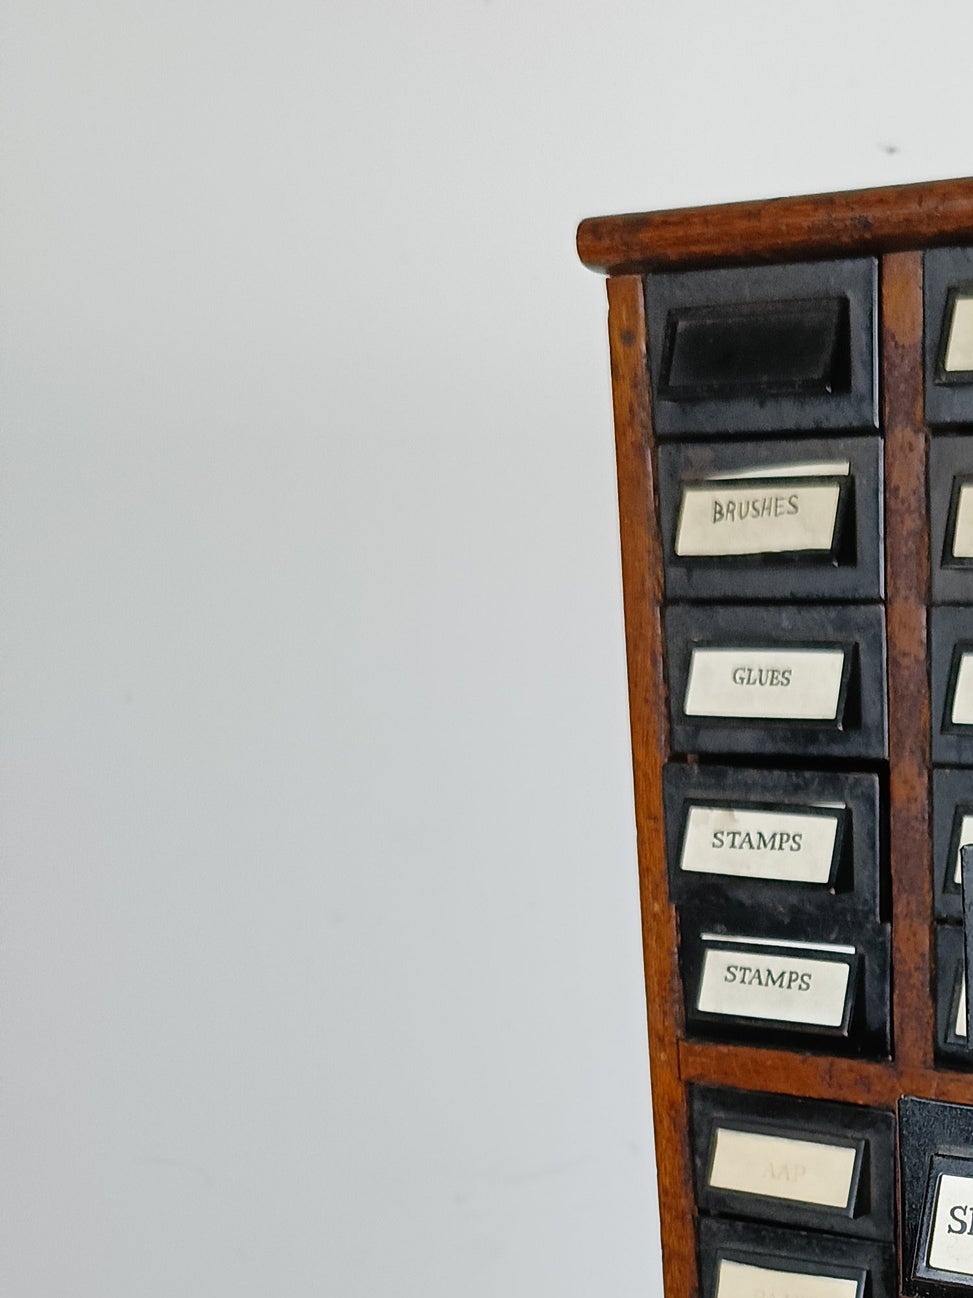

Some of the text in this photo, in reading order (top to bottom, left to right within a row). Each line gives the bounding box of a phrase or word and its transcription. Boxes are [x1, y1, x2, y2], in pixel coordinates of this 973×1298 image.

[712, 495, 799, 524] BRUSHES
[731, 666, 792, 687] GLUES
[711, 830, 803, 852] STAMPS
[724, 965, 812, 991] STAMPS
